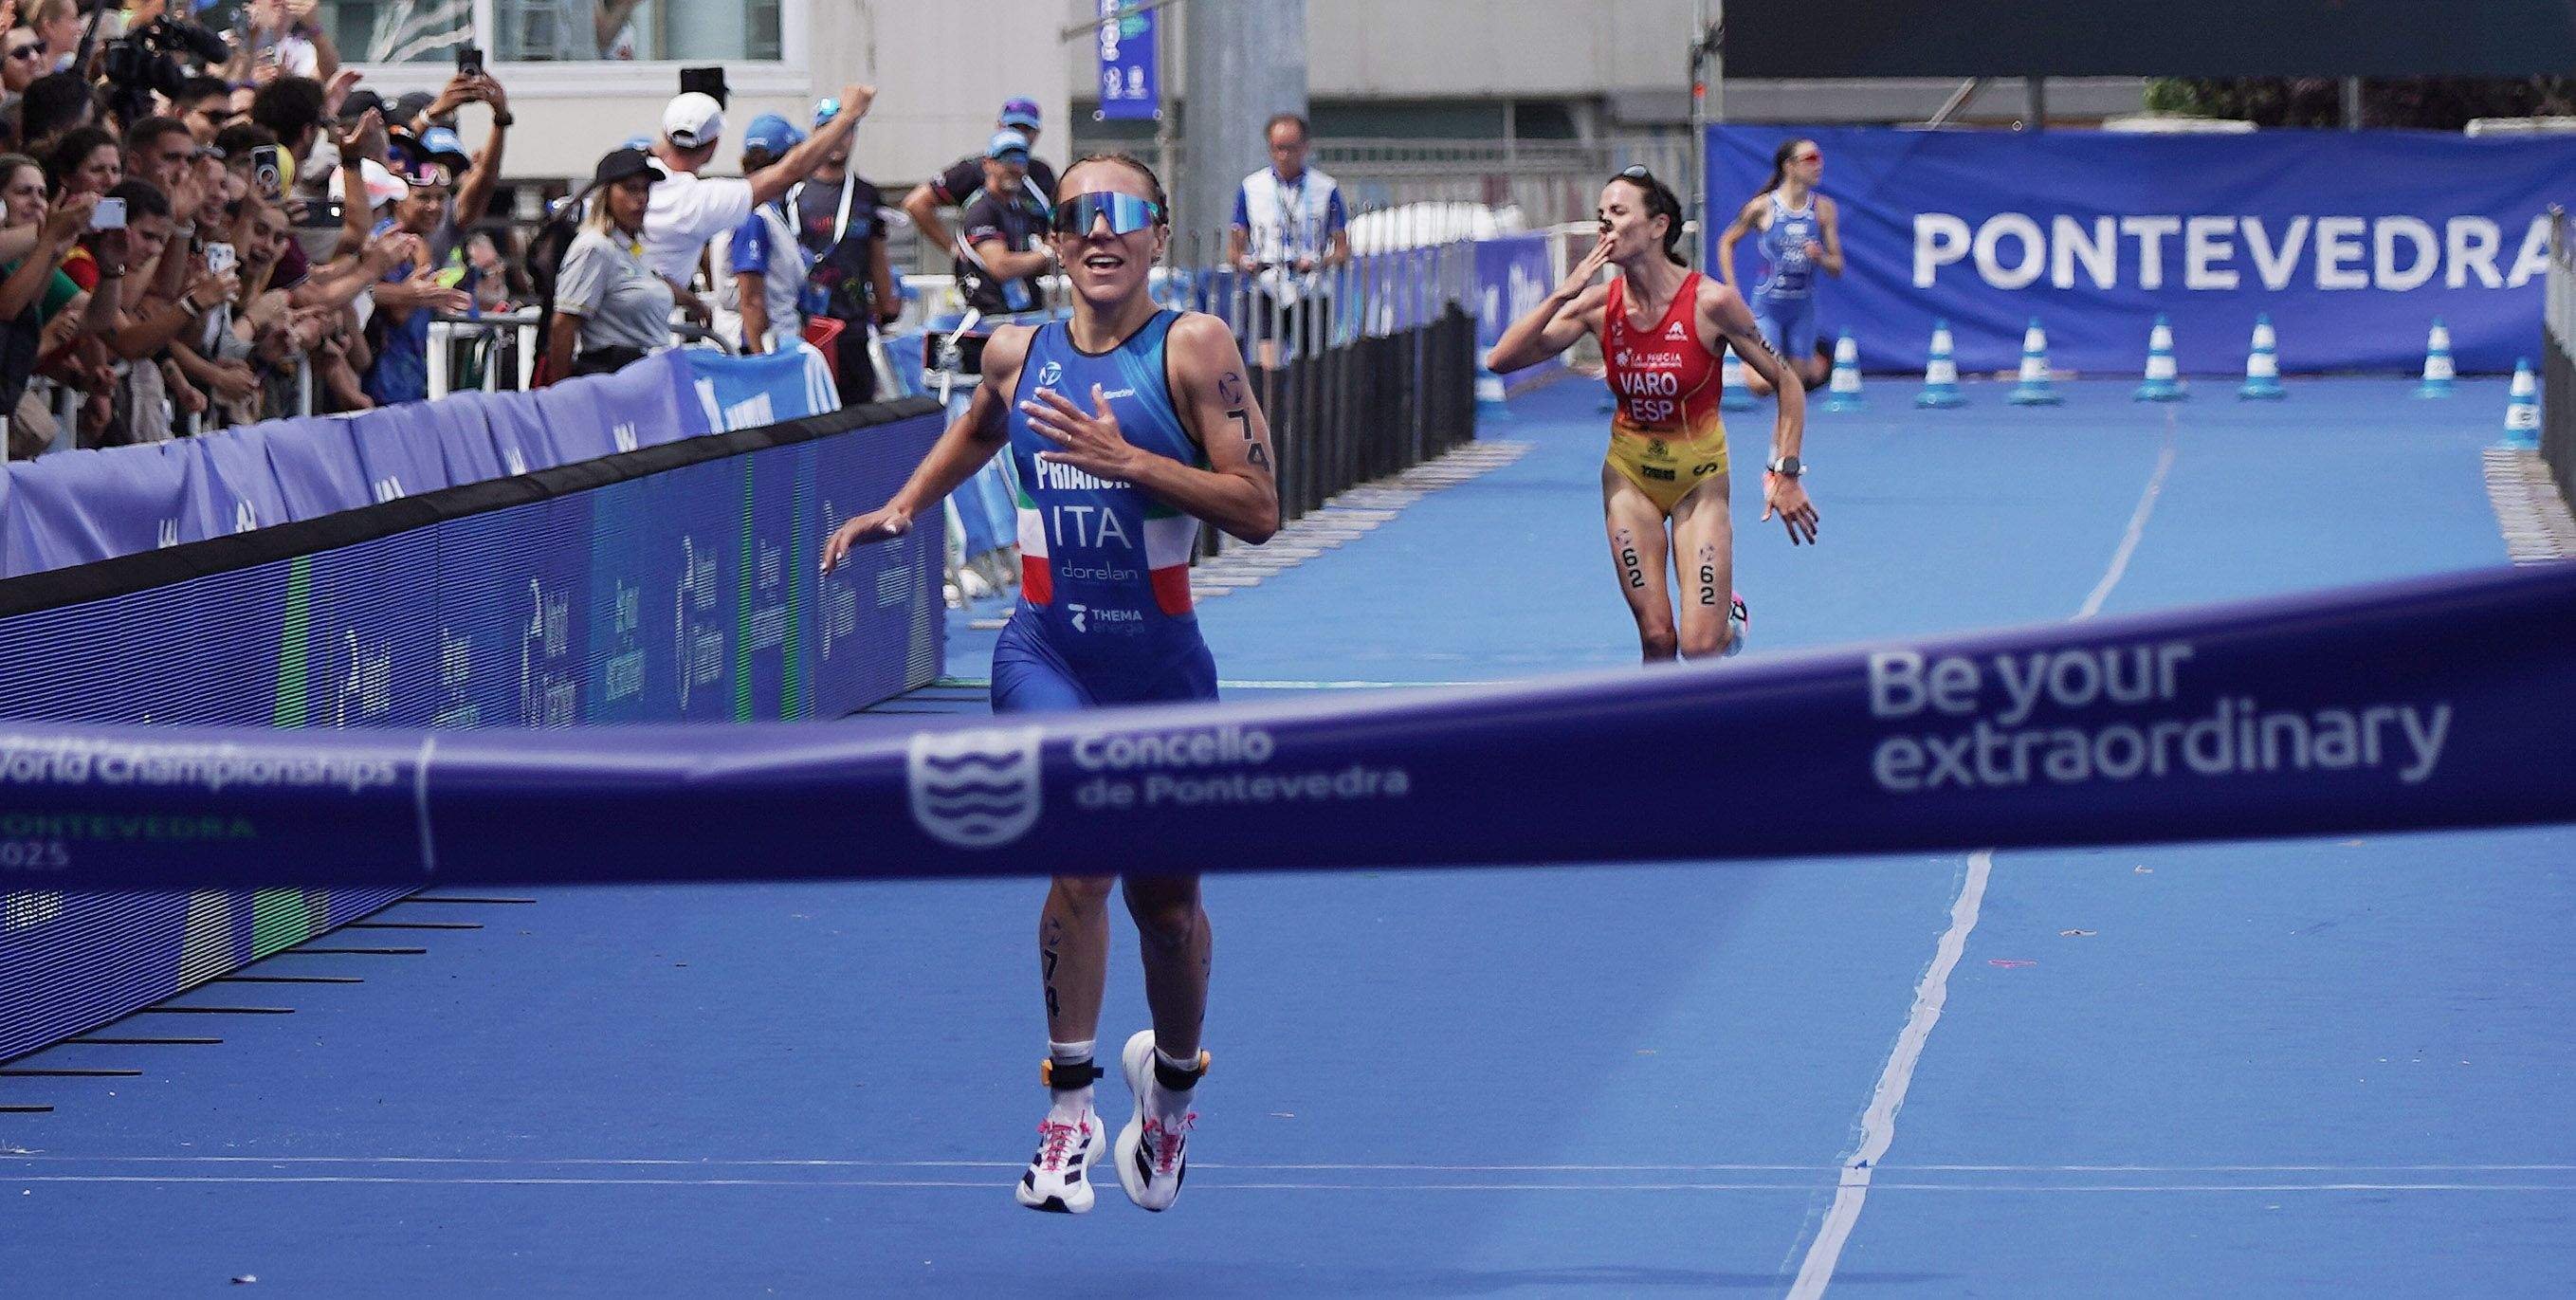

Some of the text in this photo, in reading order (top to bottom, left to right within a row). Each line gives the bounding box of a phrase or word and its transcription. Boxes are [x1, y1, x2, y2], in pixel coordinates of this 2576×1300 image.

[1619, 372, 1678, 395] VARO
[1631, 398, 1675, 421] ESP
[1053, 505, 1133, 549] ITA
[1061, 559, 1138, 580] dorelan
[1621, 548, 1645, 588] 62
[1700, 565, 1715, 605] 62
[1092, 609, 1143, 622] THEMA
[1870, 641, 2194, 727] Be your
[1074, 725, 1275, 769] Concello
[1871, 696, 2454, 792] extraordinary
[1076, 764, 1411, 808] de Pontevedra
